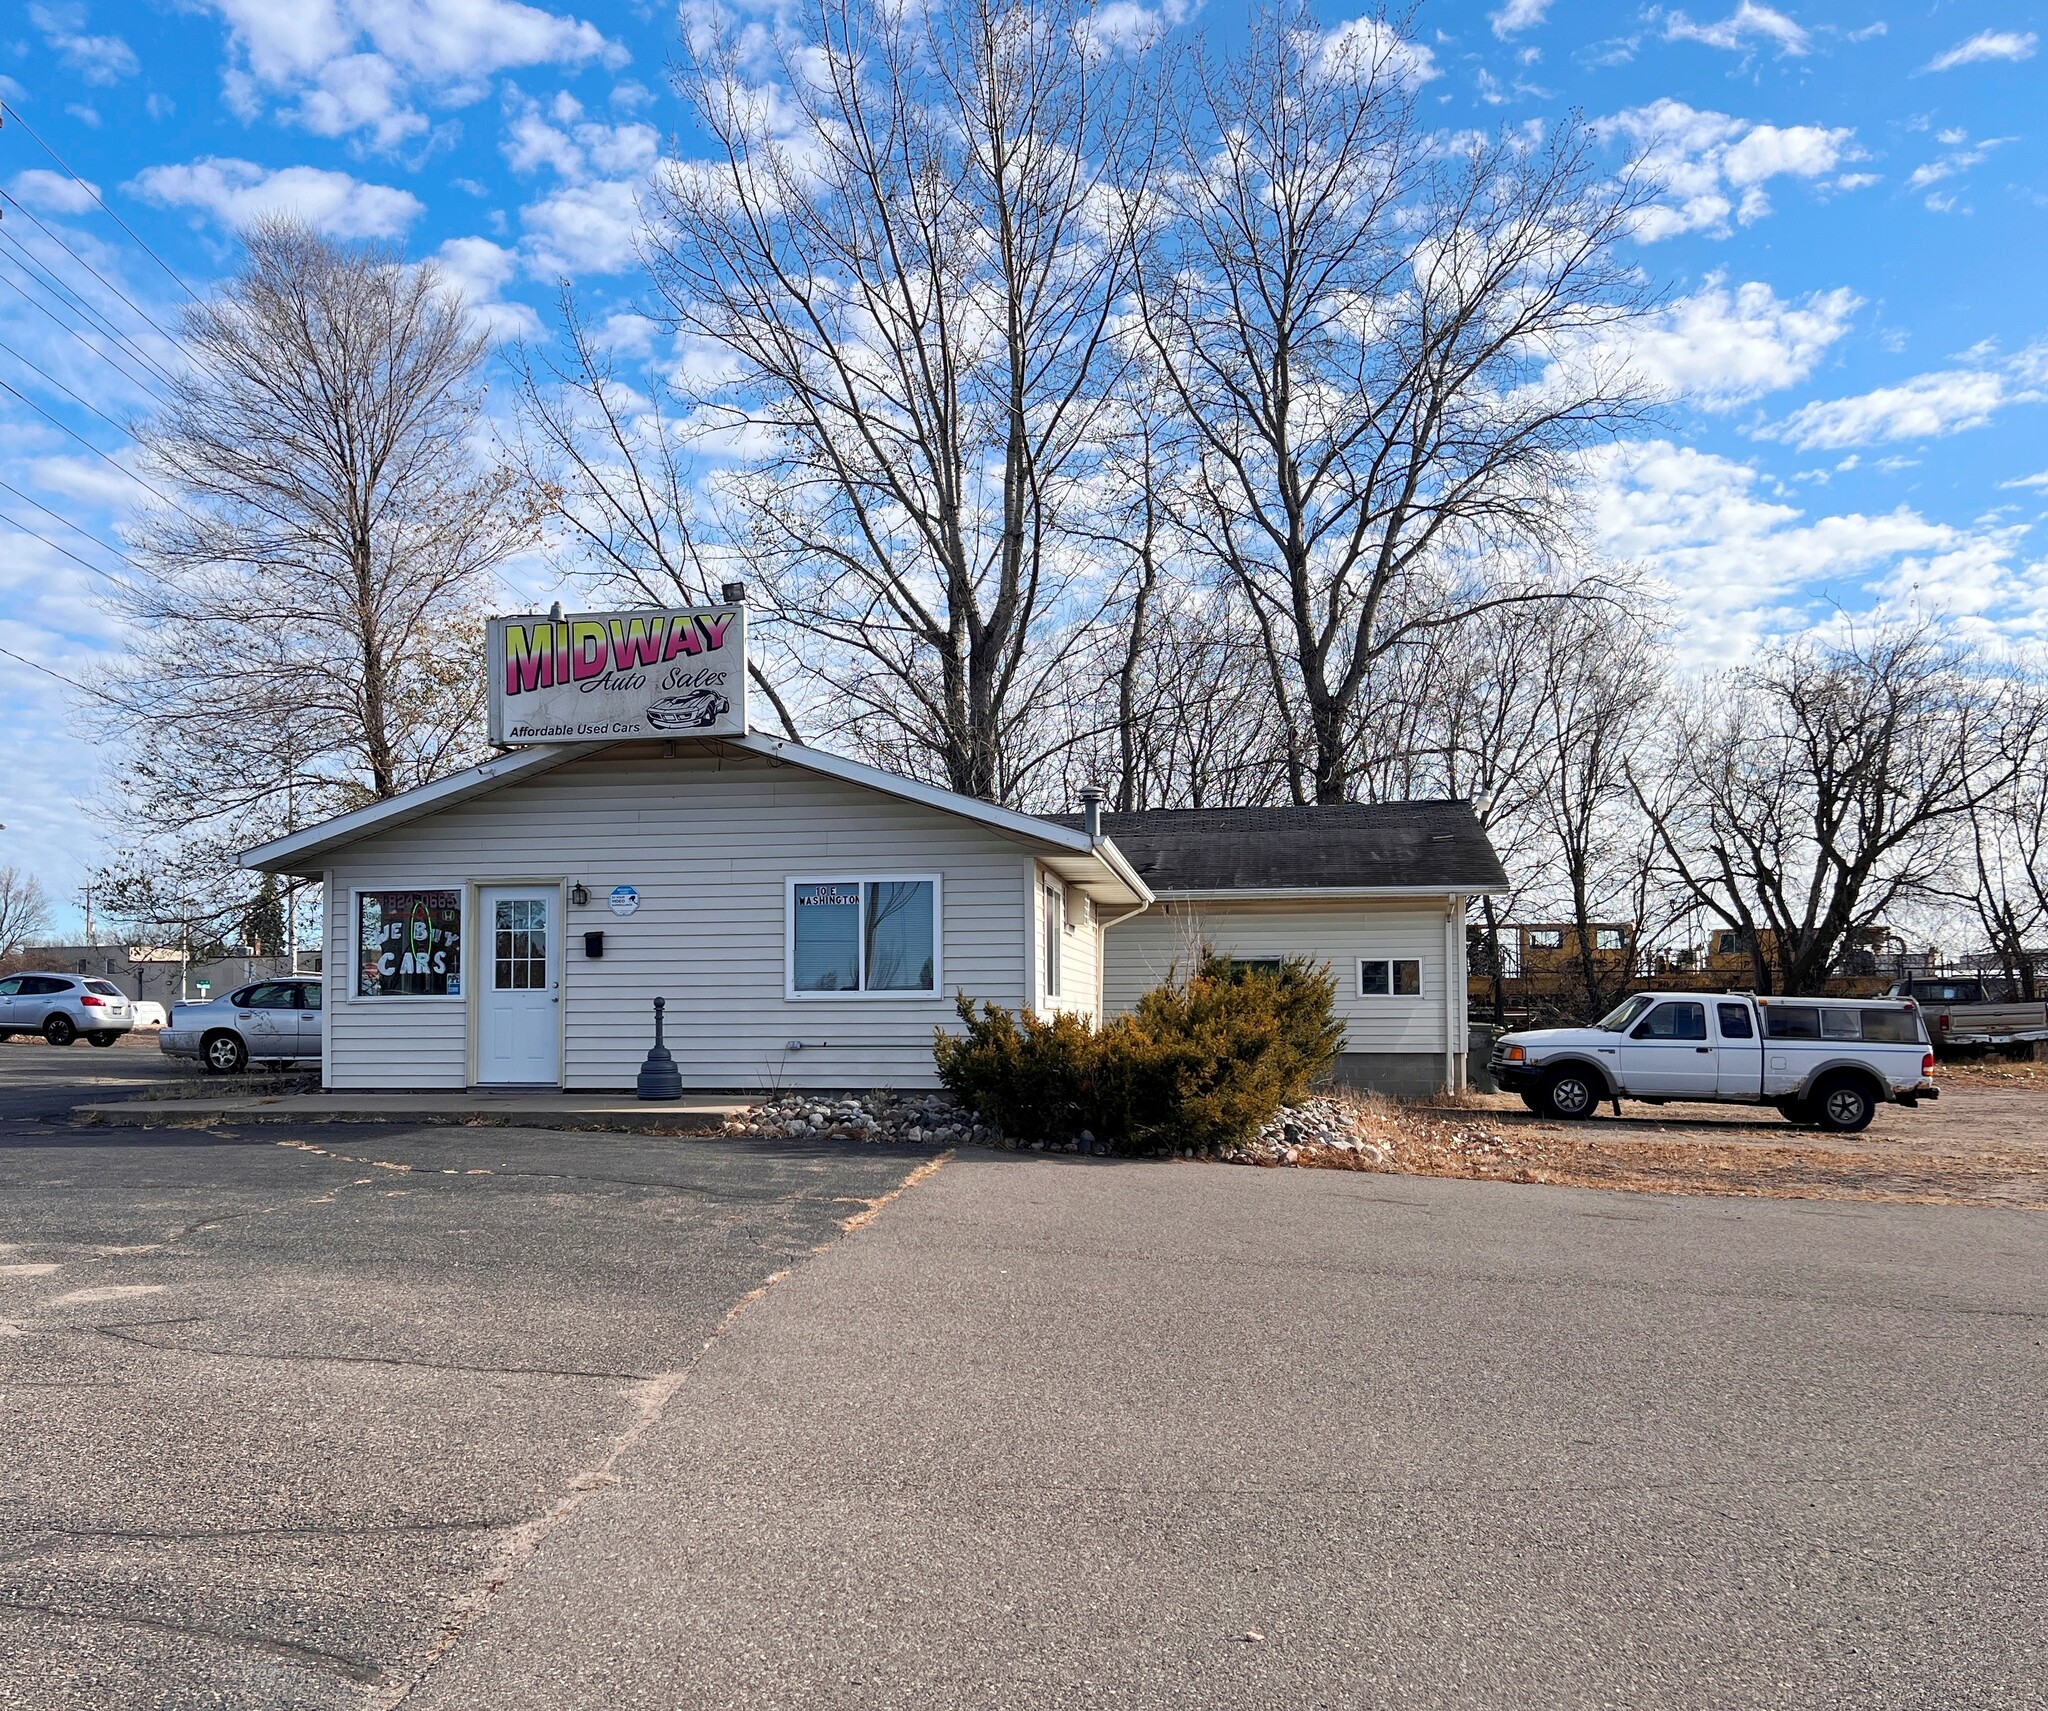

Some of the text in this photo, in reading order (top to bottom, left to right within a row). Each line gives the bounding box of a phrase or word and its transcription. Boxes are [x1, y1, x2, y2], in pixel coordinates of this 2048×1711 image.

[506, 612, 736, 696] MIDWAY
[580, 667, 727, 693] Auto Sales
[509, 722, 640, 738] Affordable Used Cars
[799, 895, 859, 906] WASHINGTON
[830, 886, 836, 896] E
[378, 951, 447, 976] CARS
